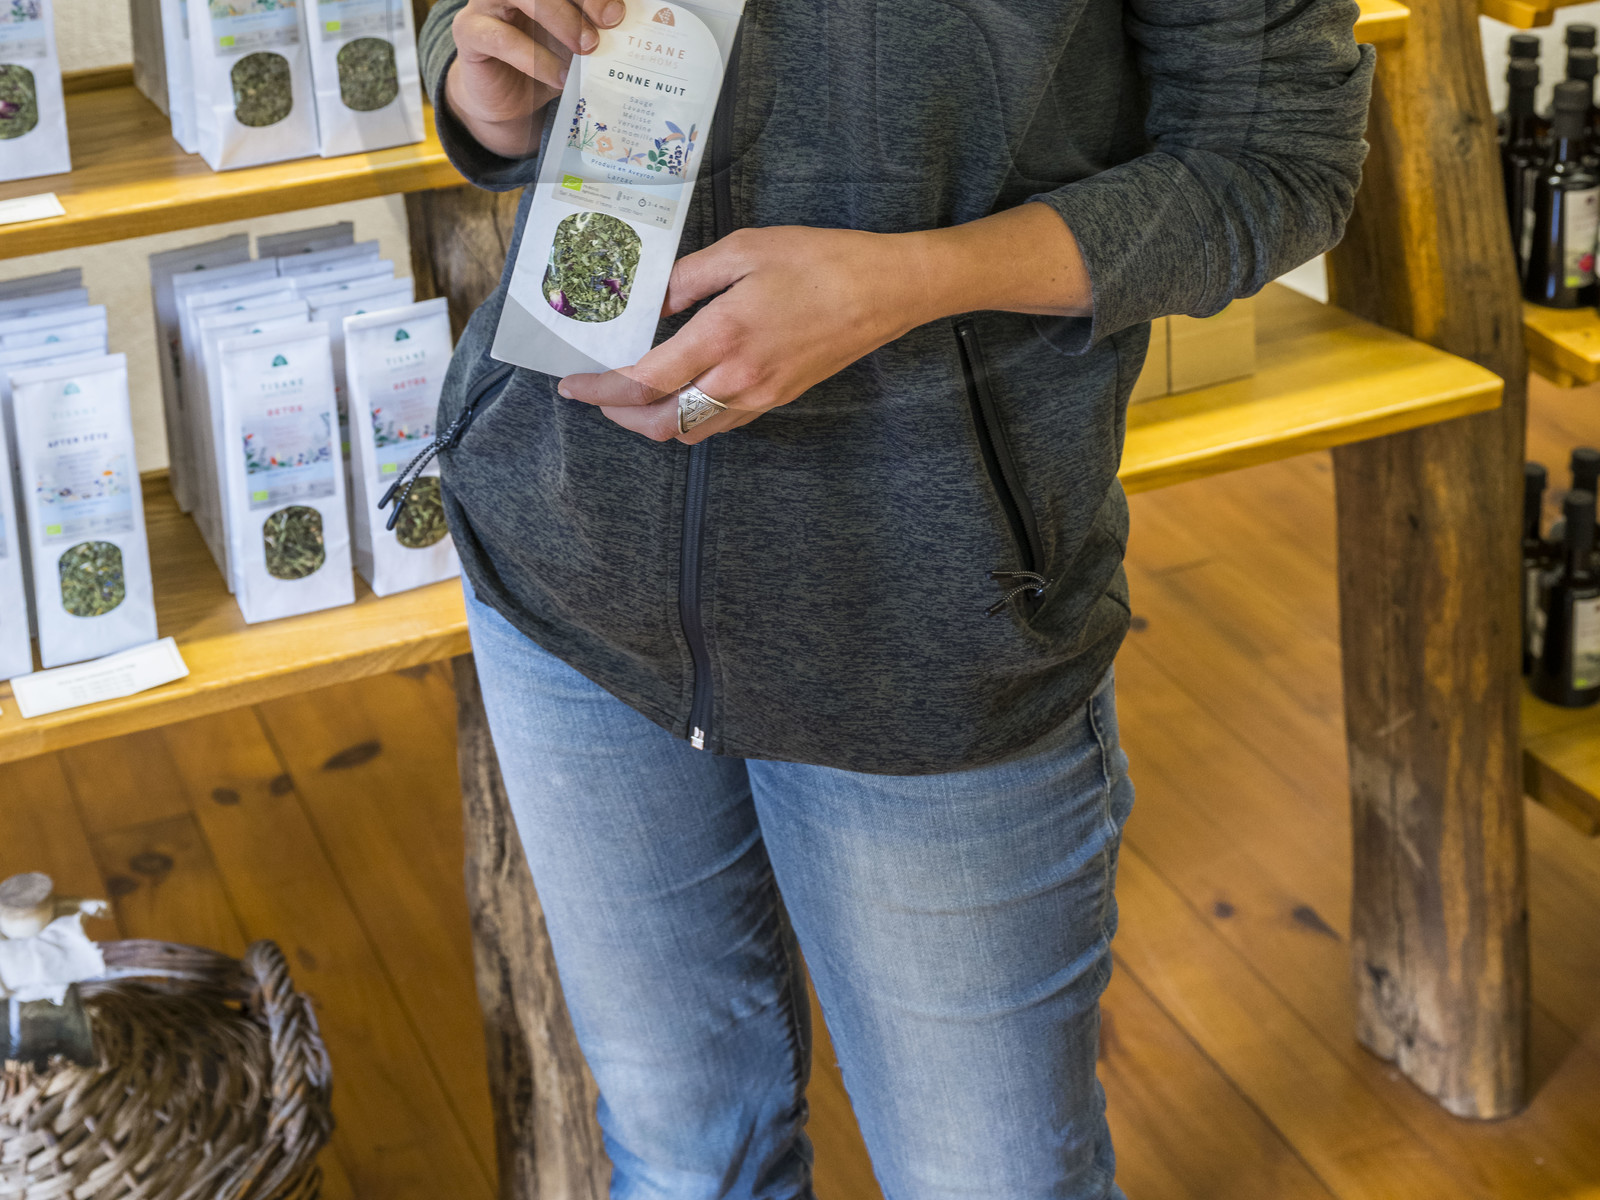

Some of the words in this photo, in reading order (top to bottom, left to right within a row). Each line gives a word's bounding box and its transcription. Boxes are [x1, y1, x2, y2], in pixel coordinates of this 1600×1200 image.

[628, 35, 686, 60] TISANE
[649, 54, 679, 70] HOMS
[608, 68, 651, 88] BONNE
[655, 81, 687, 97] NUIT
[629, 96, 654, 108] Sauge
[622, 103, 655, 117] Lavande
[617, 118, 652, 133] Verveine
[622, 111, 652, 125] Mélisse
[611, 125, 653, 142] Camomille
[621, 136, 640, 147] Rose
[590, 158, 616, 171] Produit
[628, 168, 656, 181] Aveyron
[607, 173, 633, 185] Larzac
